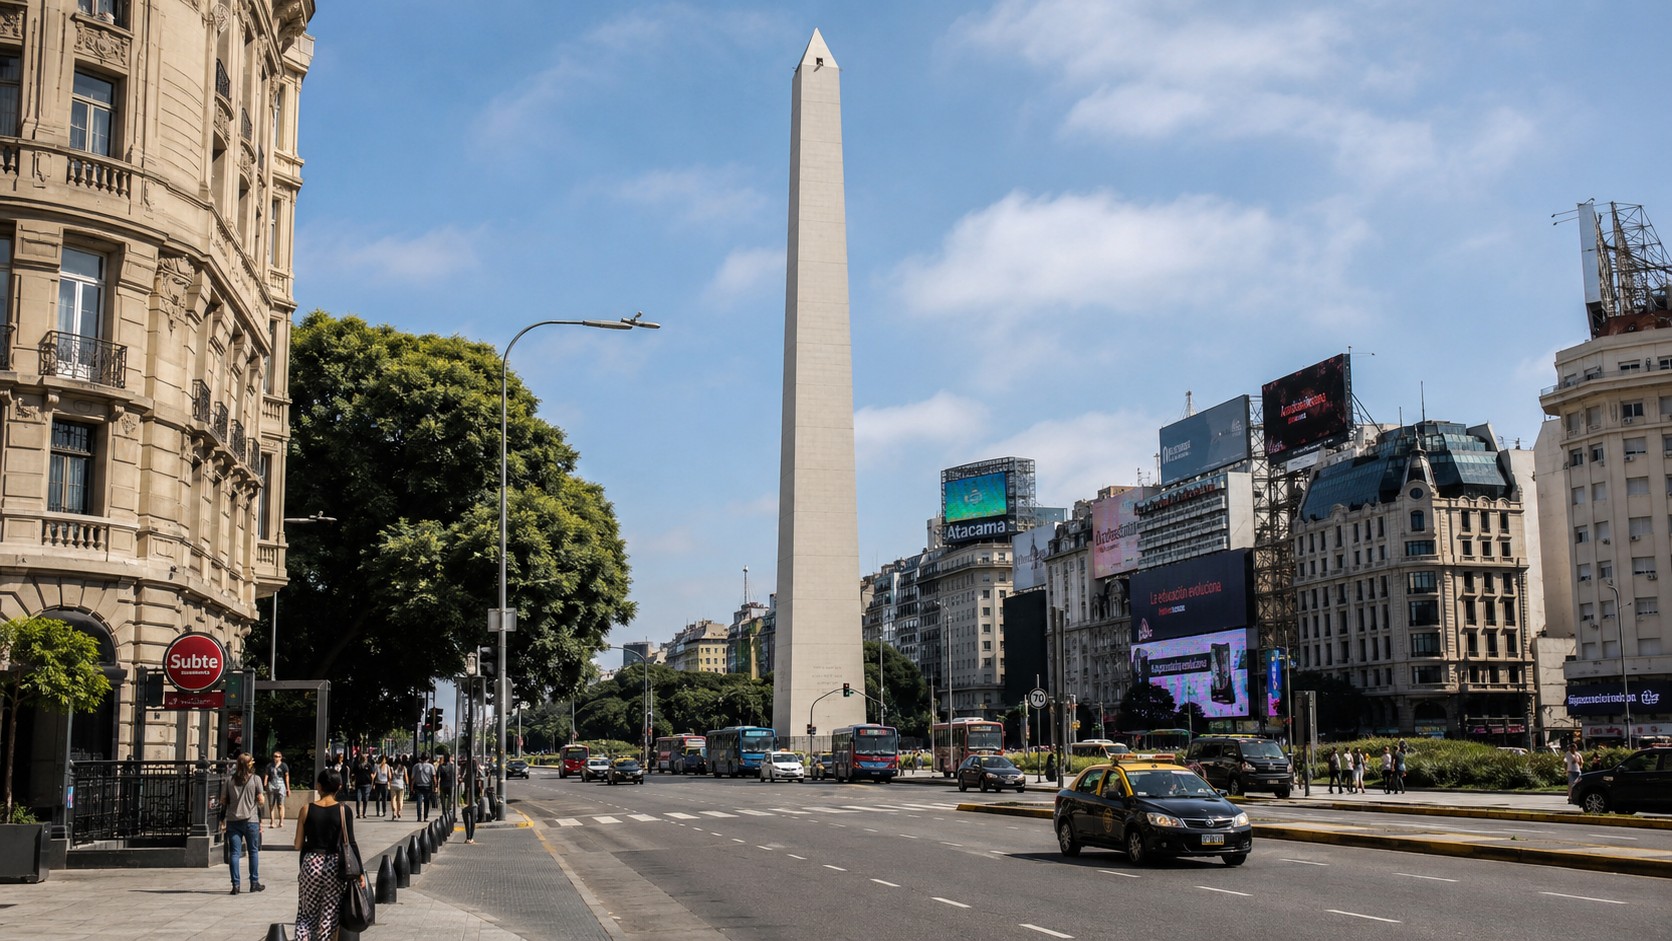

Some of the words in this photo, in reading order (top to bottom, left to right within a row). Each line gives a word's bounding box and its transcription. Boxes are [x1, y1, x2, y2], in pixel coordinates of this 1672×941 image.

[947, 520, 1006, 540] Atacama
[170, 653, 218, 669] Subte
[1033, 693, 1045, 703] 70
